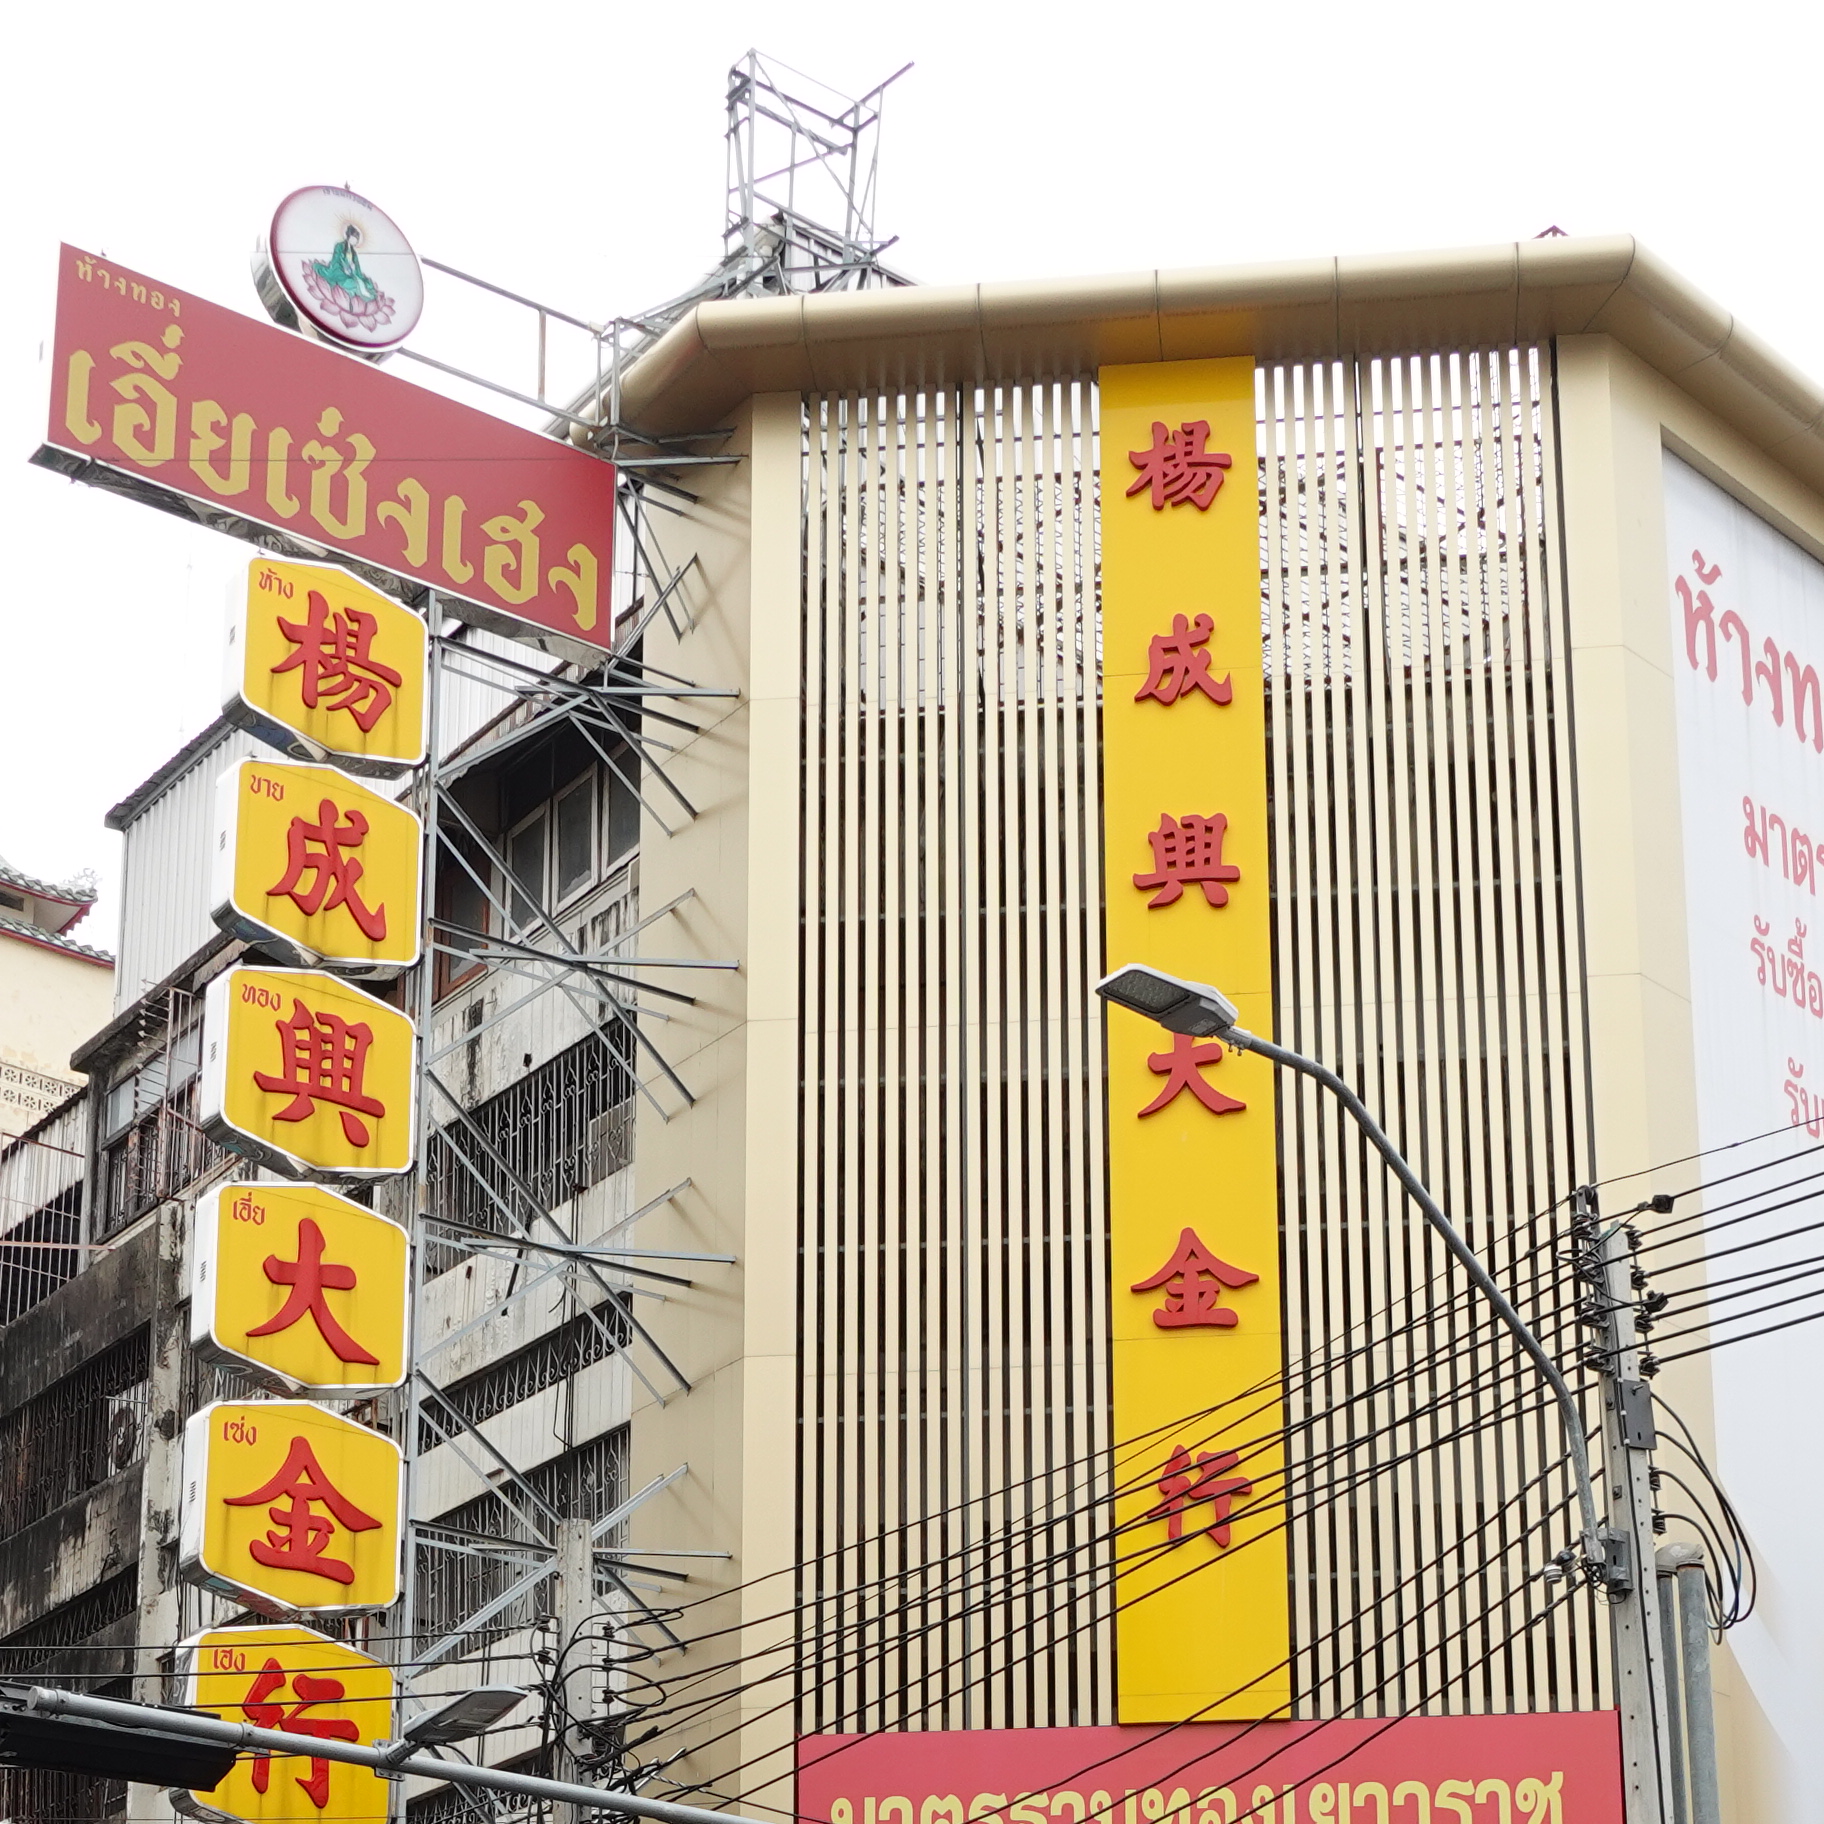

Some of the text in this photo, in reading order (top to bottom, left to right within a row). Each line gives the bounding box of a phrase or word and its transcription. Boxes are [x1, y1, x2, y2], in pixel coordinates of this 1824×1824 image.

[76, 255, 181, 318] ห้างทอง
[66, 324, 598, 632] เอี่ยเซ่งเฮง
[258, 567, 294, 601] ห้าง
[249, 773, 285, 803] ขาย
[241, 982, 282, 1013] ทอง
[232, 1197, 265, 1228] เอี่ย
[222, 1418, 258, 1448] เซ่ง
